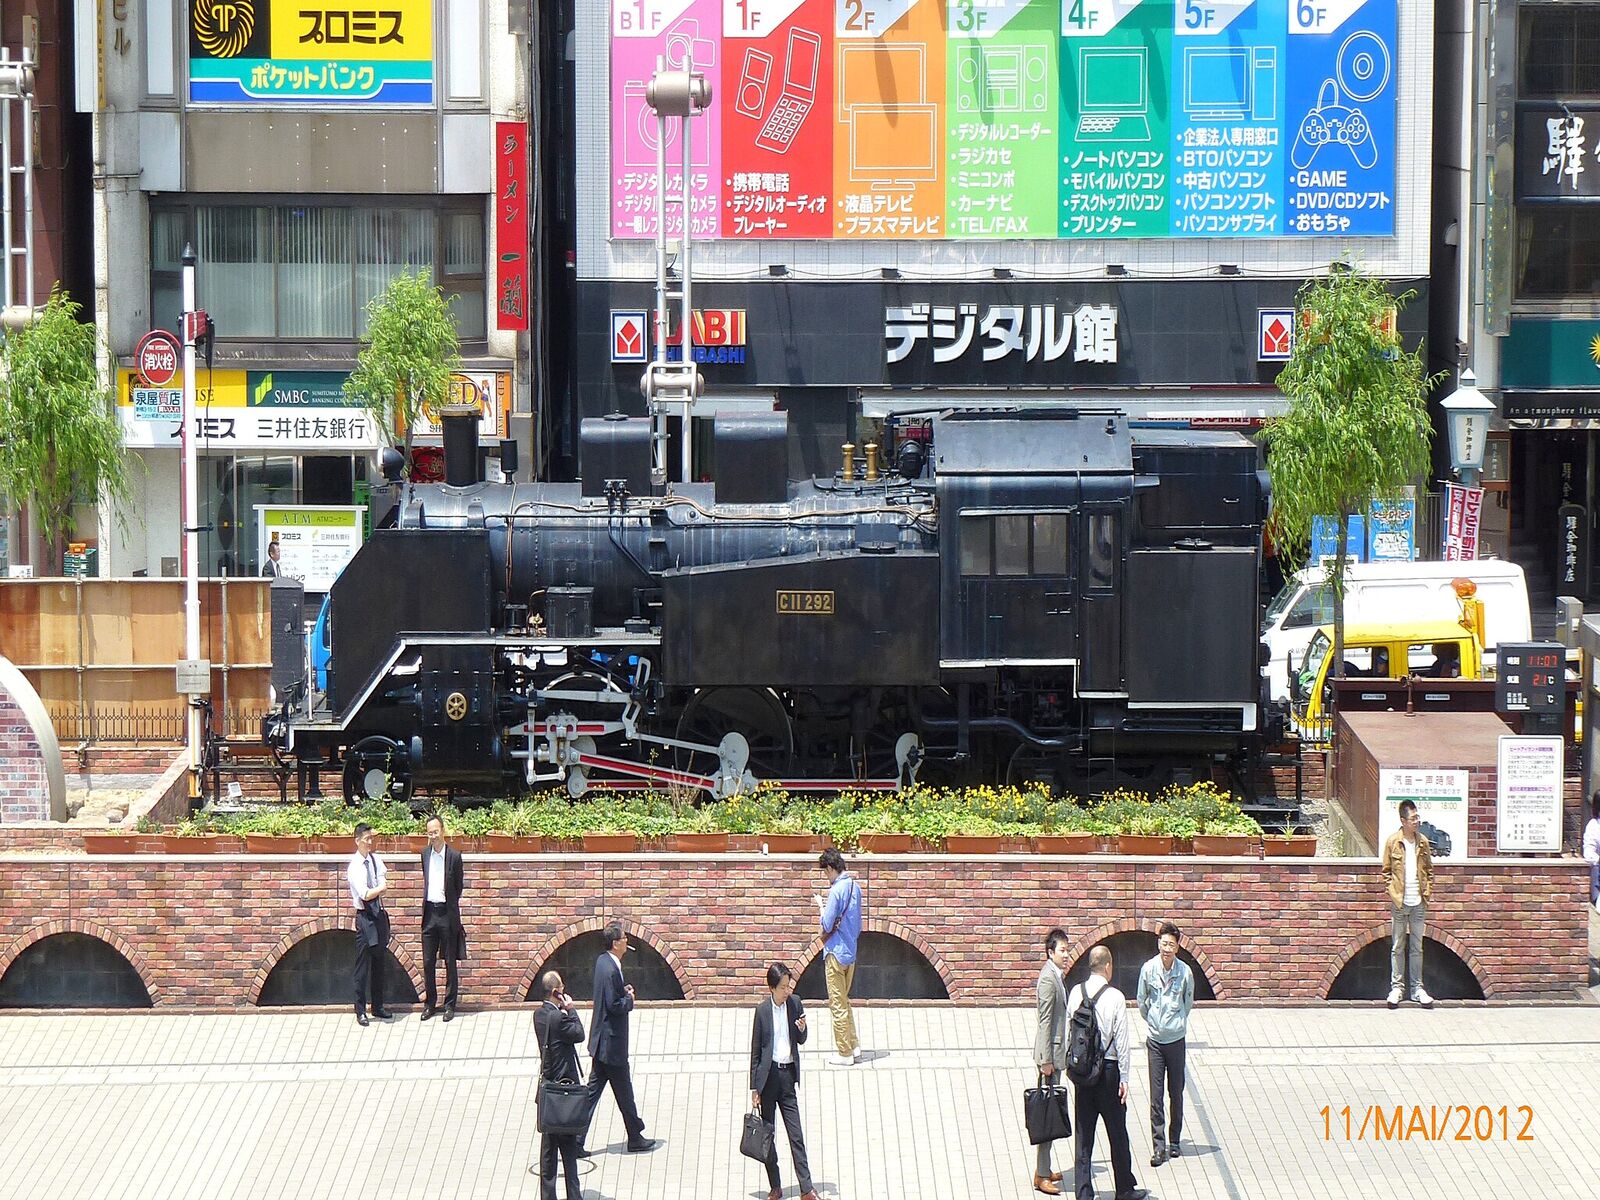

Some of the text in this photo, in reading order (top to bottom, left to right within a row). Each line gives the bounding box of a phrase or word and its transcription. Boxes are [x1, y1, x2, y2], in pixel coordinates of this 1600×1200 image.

[621, 0, 661, 30] B1F
[736, 0, 761, 30] 1F
[845, 0, 875, 31] 2F
[957, 0, 987, 31] 3F
[1068, 0, 1098, 29] 4F
[1185, 0, 1215, 28] 5F
[1296, 0, 1327, 27] 6F
[299, 11, 404, 44] プロミス
[251, 63, 374, 90] ポケットバンク
[958, 122, 1051, 141] デジタルレコーダー
[1183, 127, 1278, 146] 企業法人専用窓口
[958, 148, 1012, 165] ラジカセ
[1070, 150, 1164, 169] ノートパソコン
[1183, 150, 1273, 168] BTOパソコン
[503, 136, 519, 223] ラーメン
[733, 173, 790, 192] 携帯電話
[958, 170, 1015, 188] ミニコンポ
[1070, 172, 1165, 190] モバイルパソコン
[1183, 171, 1267, 190] 中古パソコン
[1297, 171, 1347, 187] GAME
[733, 195, 827, 213] デジタルオーディオ
[845, 194, 914, 214] 液晶テレビ
[958, 194, 1013, 212] カーナビ
[1070, 194, 1164, 212] デスクトップパソコン
[1183, 193, 1275, 211] パソコンソフト
[1296, 191, 1390, 209] DVD/CDソフト
[733, 217, 787, 234] プレーヤー
[845, 216, 940, 234] プラズマテレビ
[958, 216, 1029, 233] TEL/FAX
[1071, 215, 1136, 233] プリンター
[1183, 214, 1277, 232] パソコンサプライ
[1296, 213, 1351, 231] おもちゃ
[885, 303, 1118, 364] デジタル館
[145, 352, 173, 370] 消火栓
[136, 392, 181, 405] 泉屋質店
[274, 390, 309, 404] SMBC
[257, 417, 365, 439] 三井住友銀行
[281, 513, 311, 524] ATM
[805, 594, 831, 609] 292
[1528, 655, 1558, 666] 11:07
